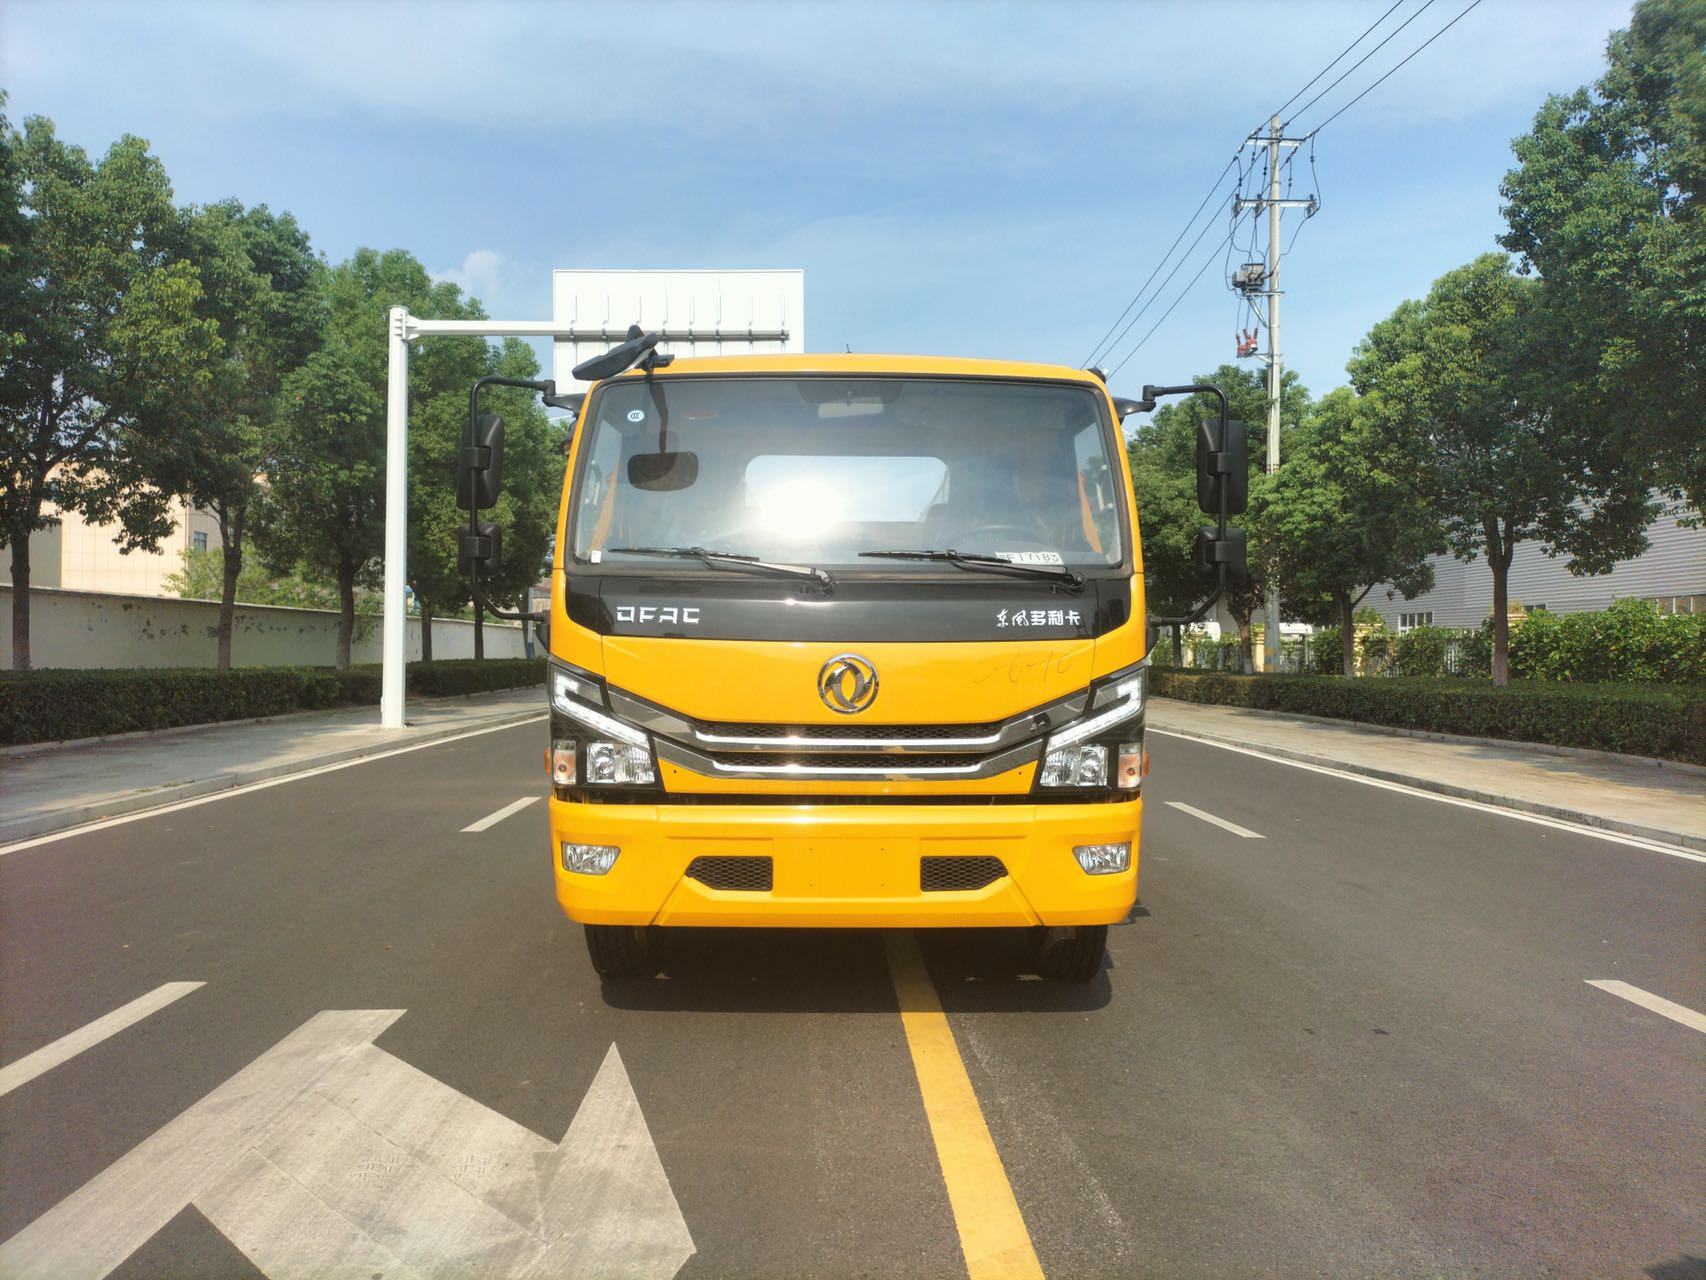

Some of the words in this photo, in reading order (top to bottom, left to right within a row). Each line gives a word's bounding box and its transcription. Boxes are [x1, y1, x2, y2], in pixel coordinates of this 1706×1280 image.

[616, 606, 700, 625] DFAC
[996, 608, 1081, 628] 东风多利卡
